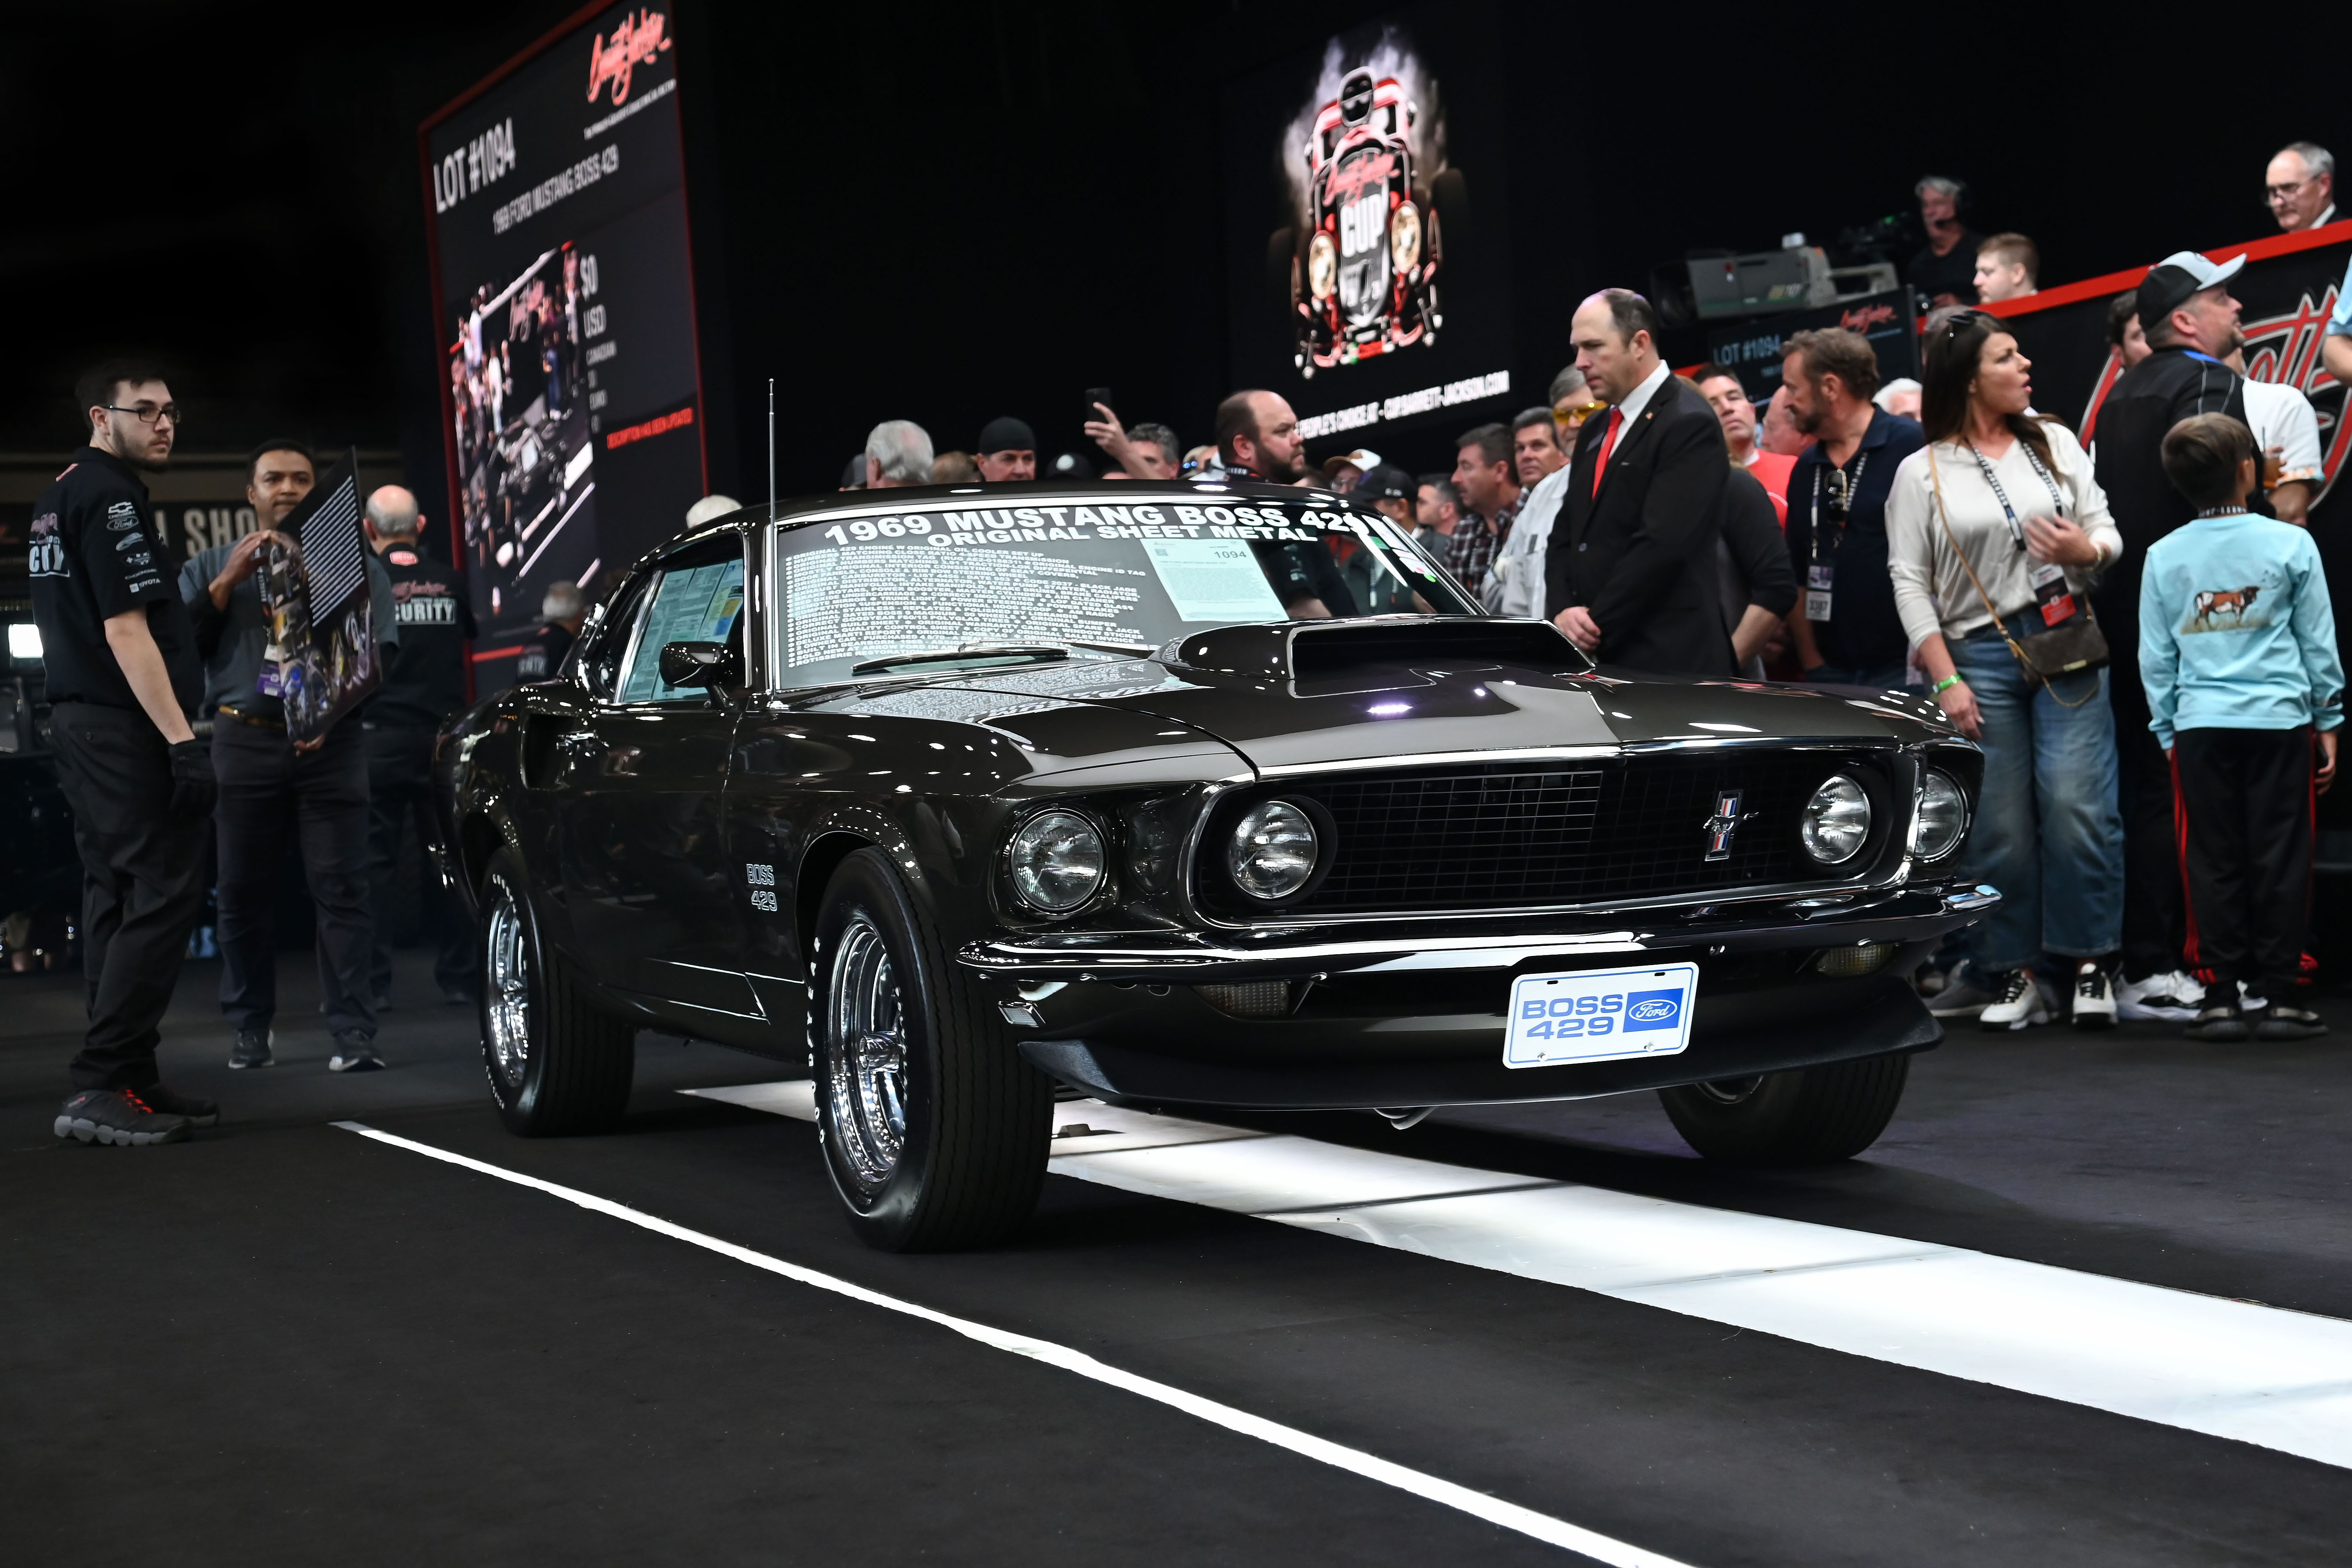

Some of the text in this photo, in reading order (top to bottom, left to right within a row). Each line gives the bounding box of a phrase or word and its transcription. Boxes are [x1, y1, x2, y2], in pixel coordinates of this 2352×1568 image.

[434, 116, 516, 214] LOT #1094
[1340, 194, 1385, 258] CUP
[1713, 343, 1740, 365] LOT
[824, 514, 932, 546] 1969
[942, 506, 1166, 532] MUSTANG
[1173, 506, 1290, 527] BOSS
[184, 507, 257, 559] SHO
[928, 525, 1318, 547] ORIGINAL SHEET METAL
[793, 548, 837, 560] ORIGINAL
[794, 552, 839, 564] NUMBERS
[998, 554, 1069, 563] TRANSMISSION
[1214, 550, 1247, 559] 1094
[793, 557, 837, 569] ORIGINAL
[793, 562, 838, 574] ORIGINAL
[1033, 565, 1098, 576] DIFFERENTIAL
[794, 567, 832, 578] MOSTLY
[1037, 570, 1079, 579] COVERS,
[794, 574, 818, 583] DOOR
[821, 570, 858, 578] PANELS,
[794, 576, 839, 588] ORIGINAL
[794, 580, 839, 592] ORIGINAL
[1090, 588, 1140, 598] RADIATOR,
[1072, 596, 1114, 604] CLEANER
[1093, 594, 1138, 602] CALIPERS
[395, 598, 454, 622] URITY
[795, 600, 830, 611] REMOTE
[795, 602, 856, 616] COMPETITION
[794, 609, 840, 621] ORIGINAL
[795, 614, 840, 626] ORIGINAL
[795, 618, 840, 630] CORRECT
[795, 624, 839, 636] ORIGINAL
[795, 629, 839, 641] ORIGINAL
[1017, 629, 1062, 637] ORIGINAL
[796, 635, 831, 647] DELUXE
[746, 863, 774, 886] BOSS
[751, 890, 777, 912] 429
[1522, 994, 1670, 1019] BOSS Ford
[1526, 1016, 1614, 1040] 429
